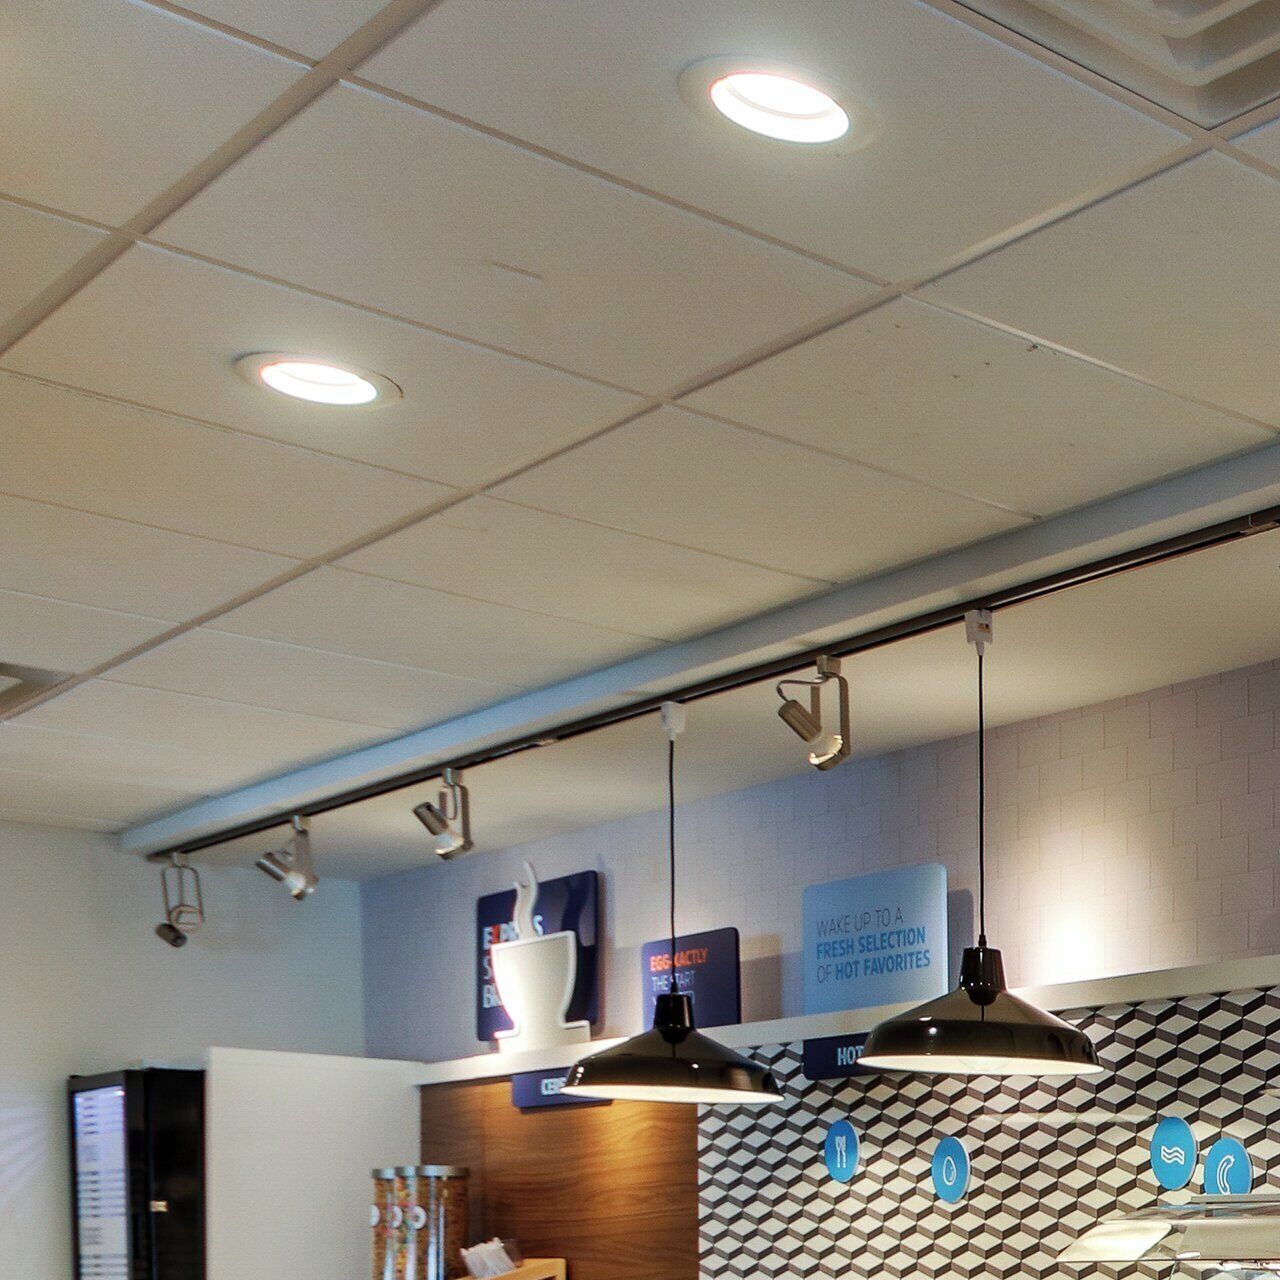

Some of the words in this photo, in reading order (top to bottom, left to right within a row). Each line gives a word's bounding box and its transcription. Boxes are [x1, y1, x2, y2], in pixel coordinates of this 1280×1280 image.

[816, 915, 851, 938] WAKE
[854, 912, 871, 932] UP
[875, 908, 890, 929] TO
[894, 907, 903, 924] A
[816, 940, 854, 960] FRESH
[859, 926, 926, 953] SELECTION
[817, 965, 833, 983] OF
[835, 961, 860, 980] HOT
[864, 950, 930, 976] FAVORITES
